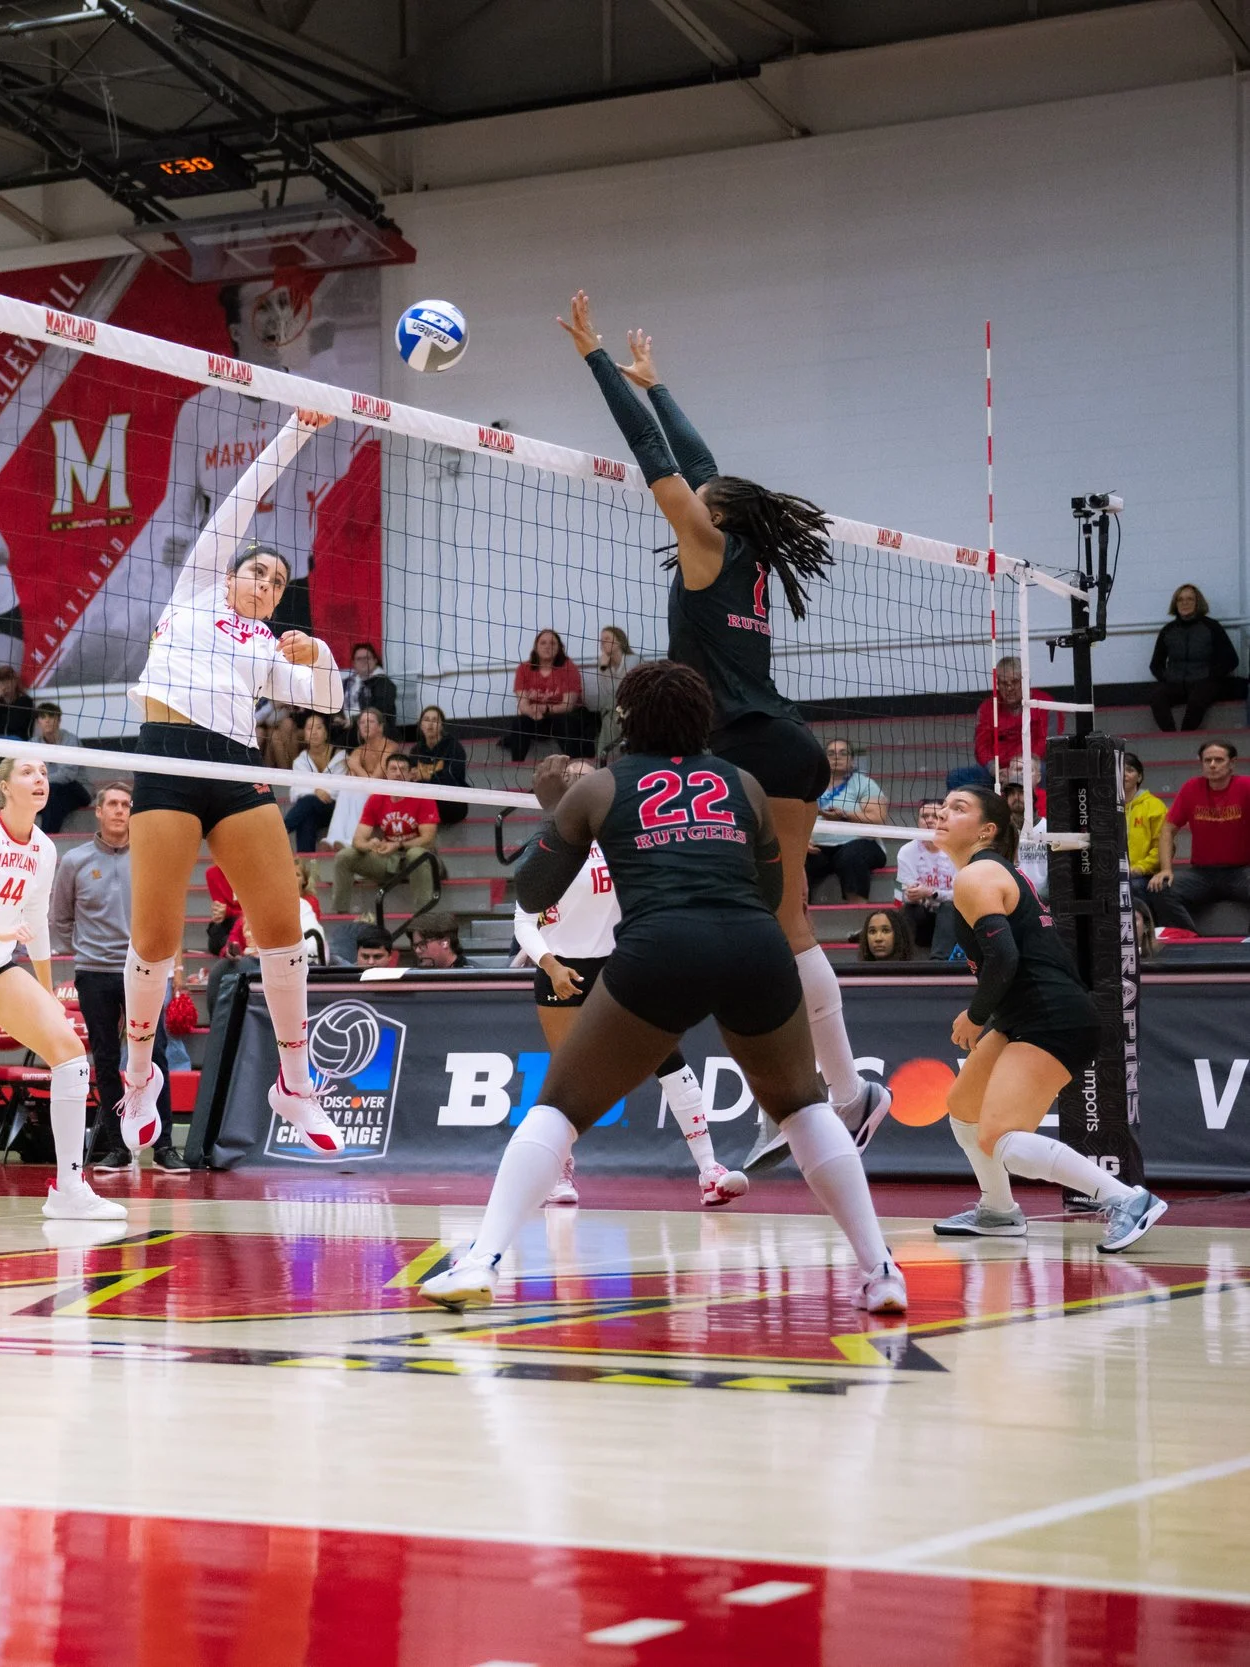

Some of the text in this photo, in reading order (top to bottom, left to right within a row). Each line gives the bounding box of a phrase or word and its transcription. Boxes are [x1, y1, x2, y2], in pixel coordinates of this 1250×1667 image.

[46, 309, 96, 341] MARYLAND
[208, 354, 253, 382] MARYLAND
[352, 393, 391, 418] MARYLAND
[478, 426, 515, 450] MARYLAND
[50, 413, 133, 517] M
[593, 456, 626, 478] MARYLAND
[637, 769, 736, 830] 22
[1078, 788, 1089, 826] sports
[634, 825, 748, 850] RUTGERS
[0, 877, 26, 906] 44
[591, 866, 612, 894] 16
[1118, 855, 1140, 1125] TERRAPINS
[323, 1096, 385, 1109] DISCOVER
[1082, 1070, 1099, 1132] imports
